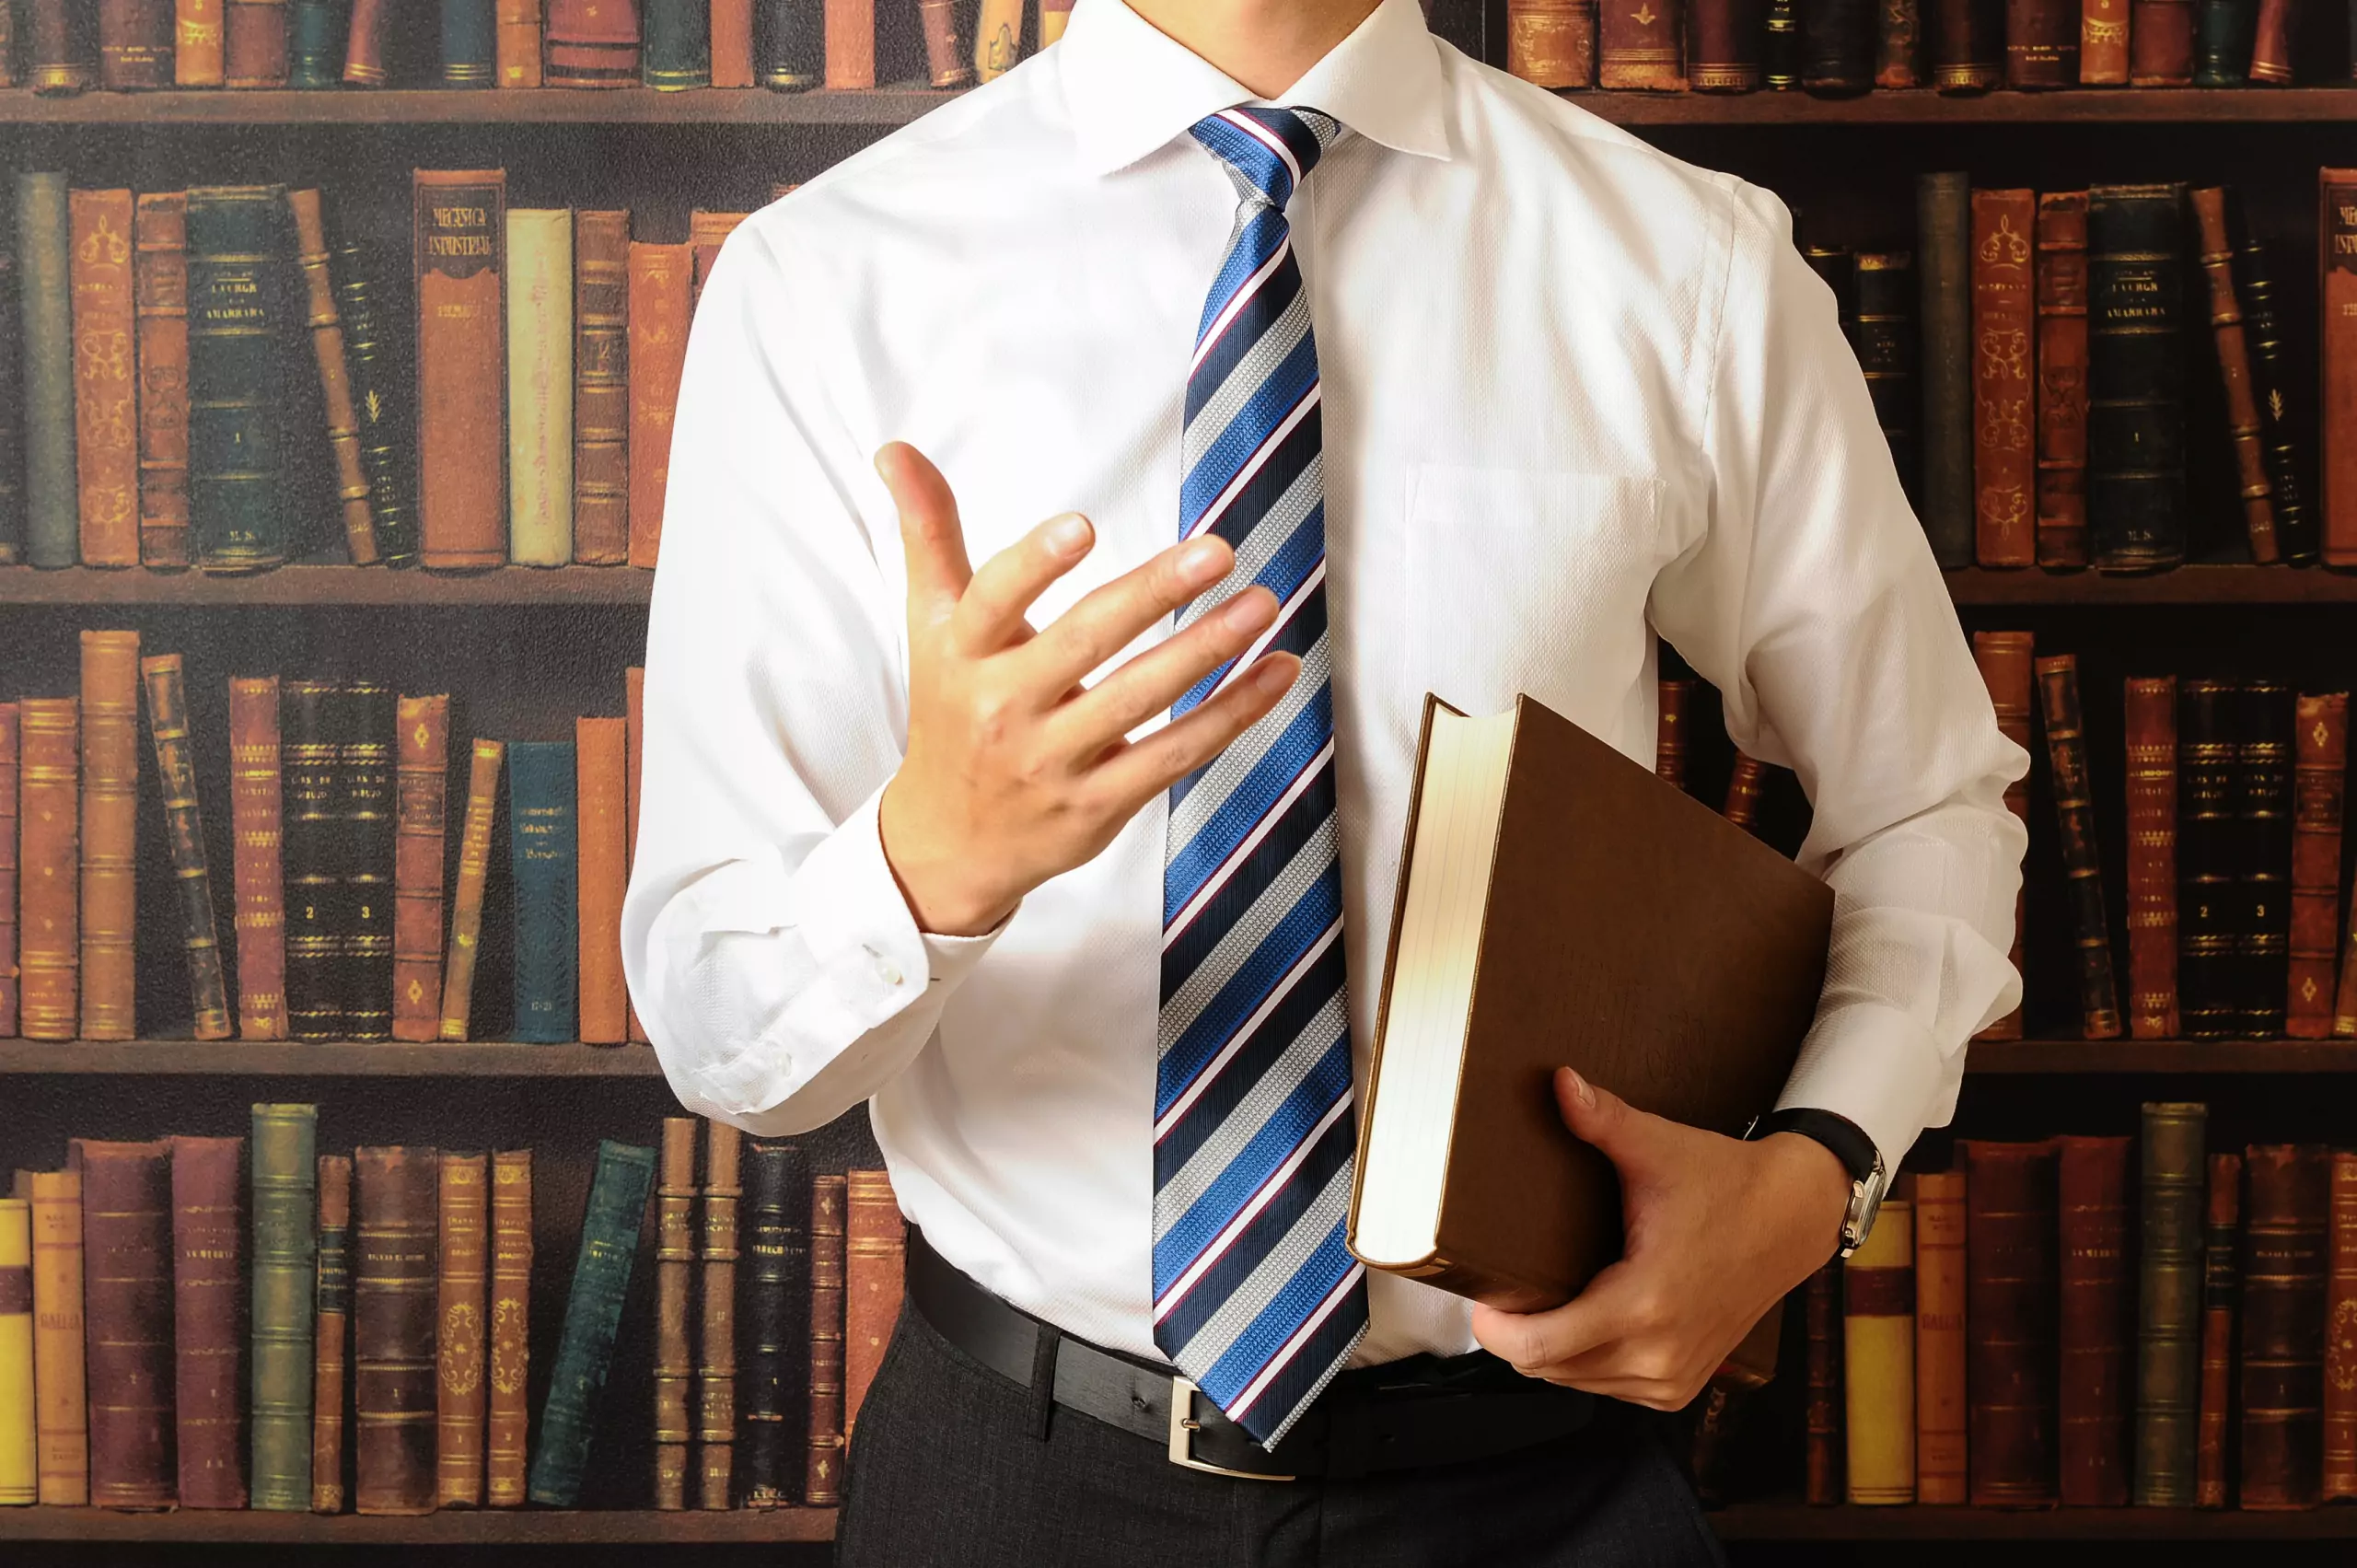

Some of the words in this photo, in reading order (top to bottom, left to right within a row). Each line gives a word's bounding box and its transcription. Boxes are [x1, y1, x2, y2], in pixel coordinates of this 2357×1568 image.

[306, 905, 314, 920] 2
[362, 905, 370, 919] 3
[2200, 906, 2209, 918] 2
[2257, 904, 2266, 917] 3
